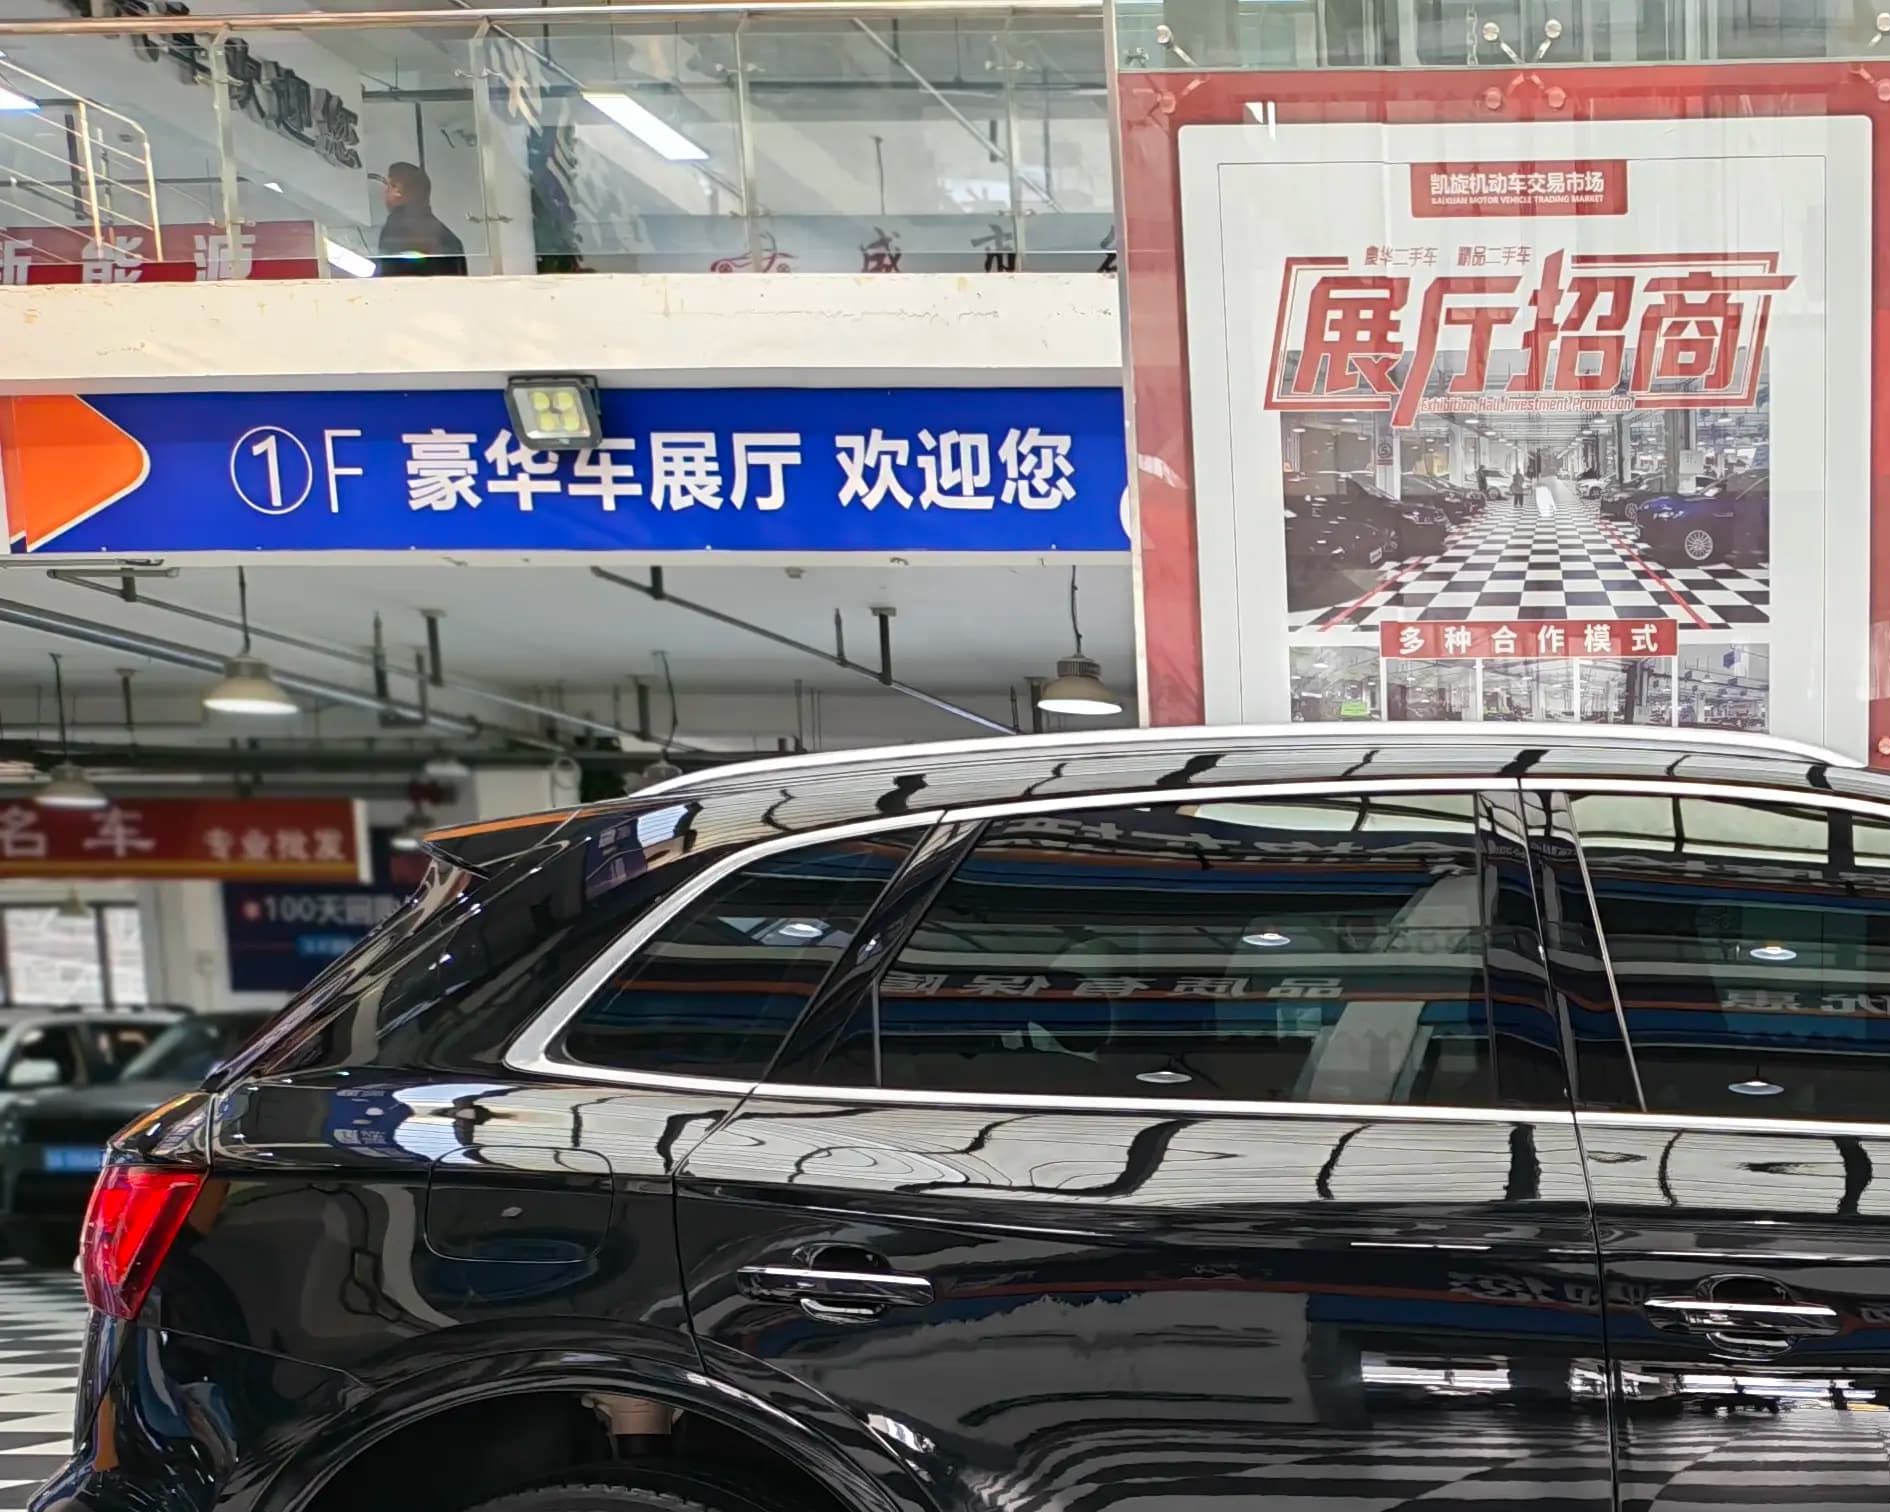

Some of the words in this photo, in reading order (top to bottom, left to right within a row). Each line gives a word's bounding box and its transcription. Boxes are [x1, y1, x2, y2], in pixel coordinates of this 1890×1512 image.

[1430, 171, 1604, 195] 凯旋机动车交易市场
[1293, 248, 1796, 427] 展厅招商
[404, 428, 802, 513] 豪华车展厅
[834, 426, 1077, 512] 欢迎您
[1399, 624, 1659, 655] 多种合作模式
